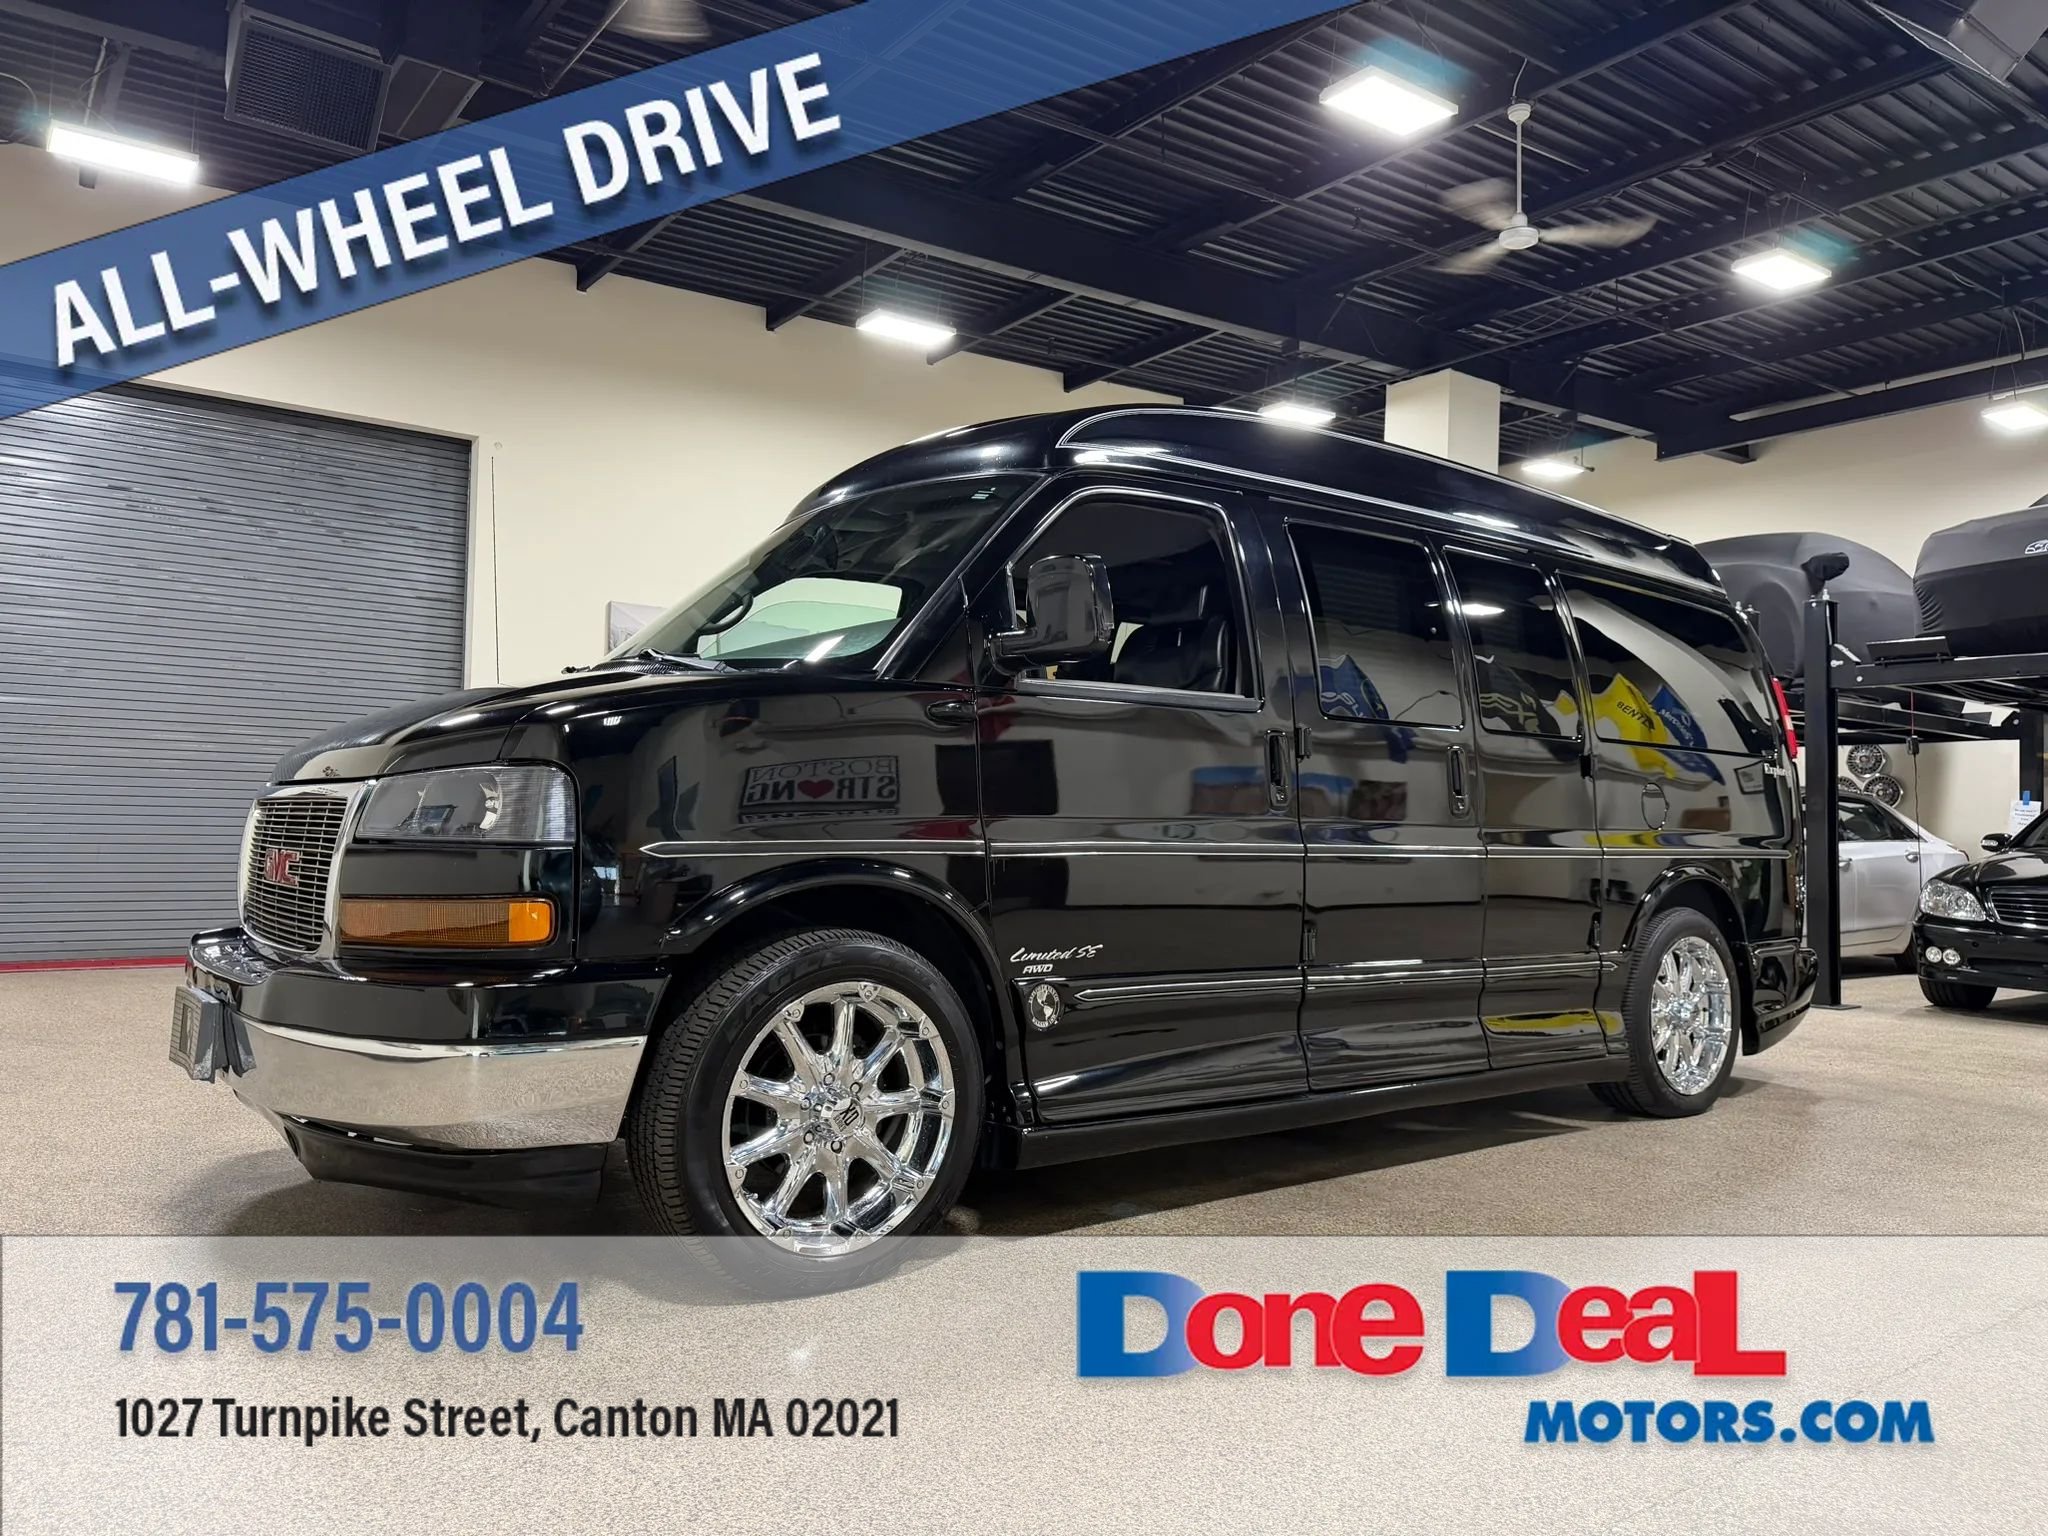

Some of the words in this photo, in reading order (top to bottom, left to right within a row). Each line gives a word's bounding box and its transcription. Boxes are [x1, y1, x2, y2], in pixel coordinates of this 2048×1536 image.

[264, 848, 300, 887] GMC
[1010, 947, 1077, 962] Limited
[1075, 944, 1104, 958] SE
[1022, 963, 1054, 974] AWD
